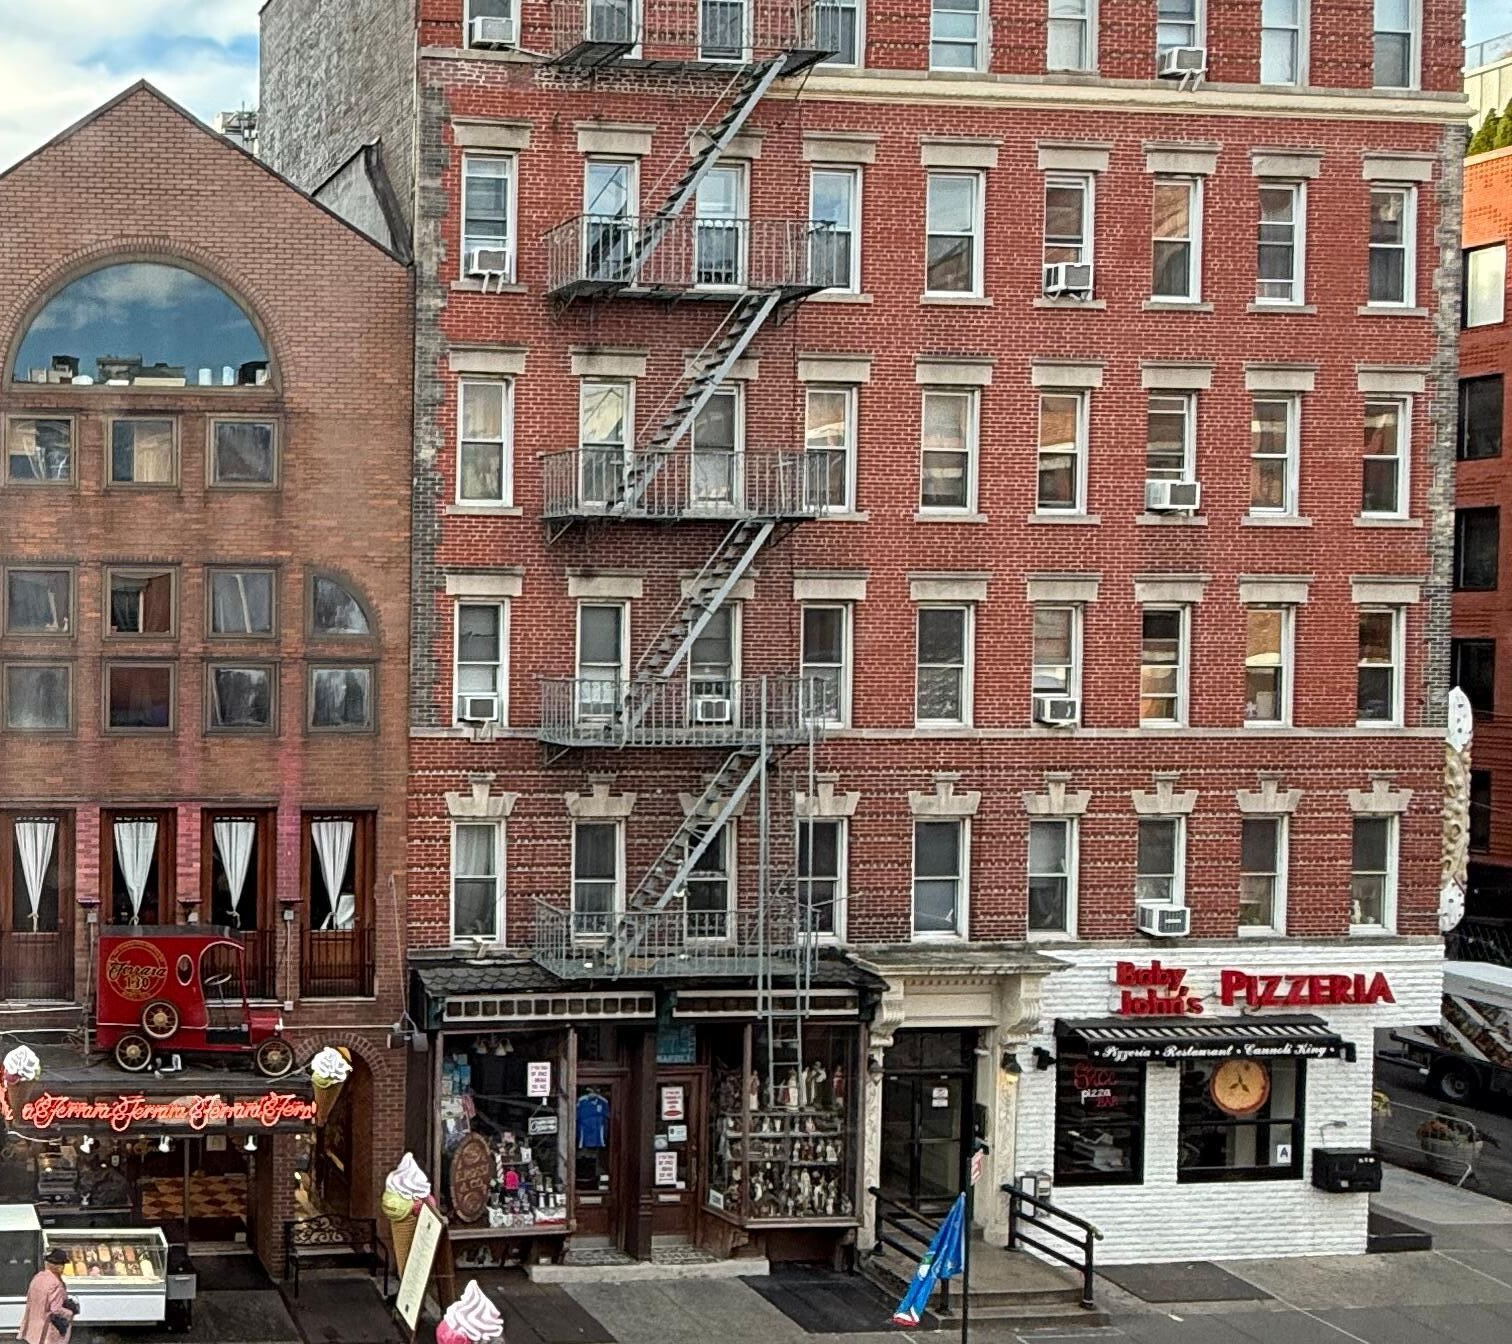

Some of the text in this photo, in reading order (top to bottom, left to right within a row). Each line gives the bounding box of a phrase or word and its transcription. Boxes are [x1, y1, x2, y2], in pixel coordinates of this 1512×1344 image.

[107, 961, 168, 981] Ferrara
[1116, 960, 1187, 992] Baby
[1220, 969, 1396, 1006] PIZZERIA
[1116, 986, 1204, 1016] John's
[1102, 1040, 1327, 1062] Pizzeria Restaurant Cannoli King
[1081, 1088, 1112, 1105] pizza
[33, 1092, 111, 1129] Ferrara
[110, 1094, 188, 1132] Ferrara
[188, 1094, 262, 1130] Ferrara
[1279, 1147, 1289, 1158] A
